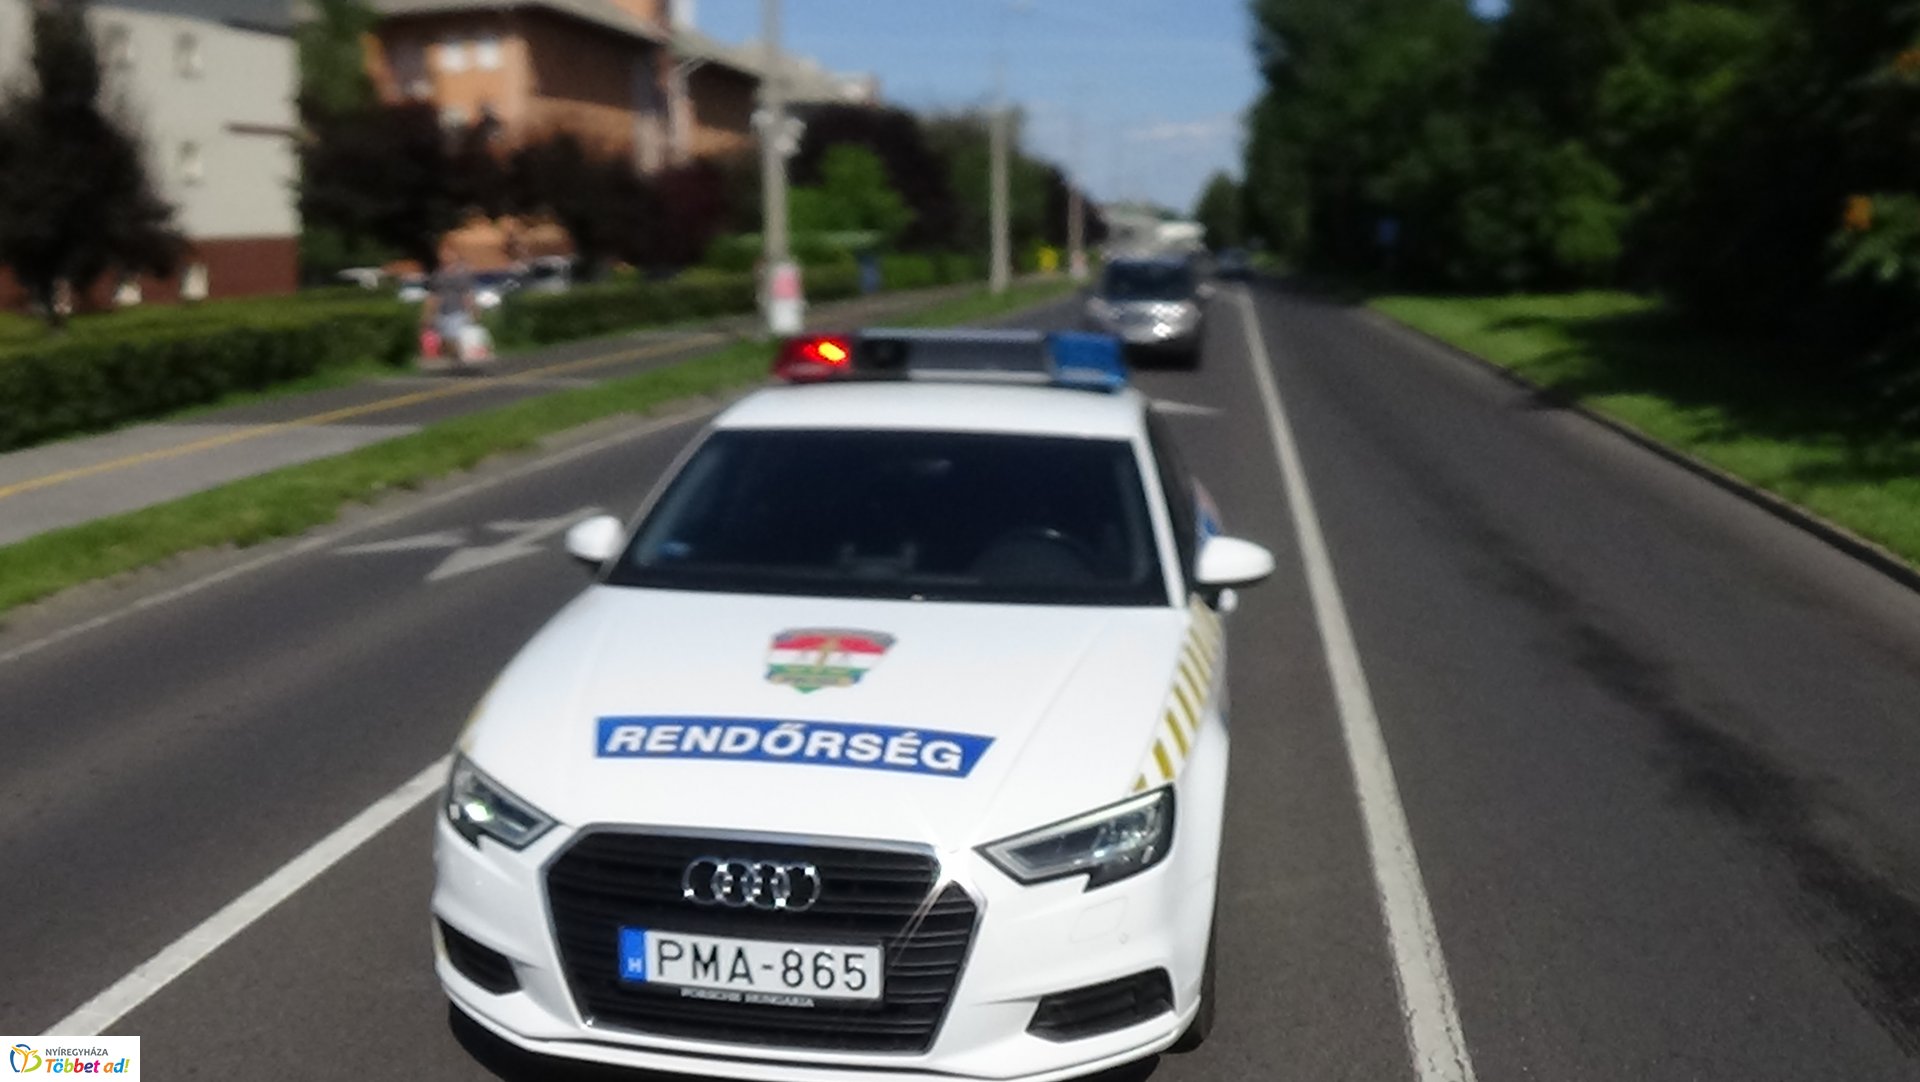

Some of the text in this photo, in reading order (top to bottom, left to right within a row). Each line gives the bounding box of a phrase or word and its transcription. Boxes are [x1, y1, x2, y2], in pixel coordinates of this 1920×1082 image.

[605, 722, 965, 772] RENDŐRSÉG
[627, 957, 642, 973] H
[656, 938, 867, 991] PMA-865
